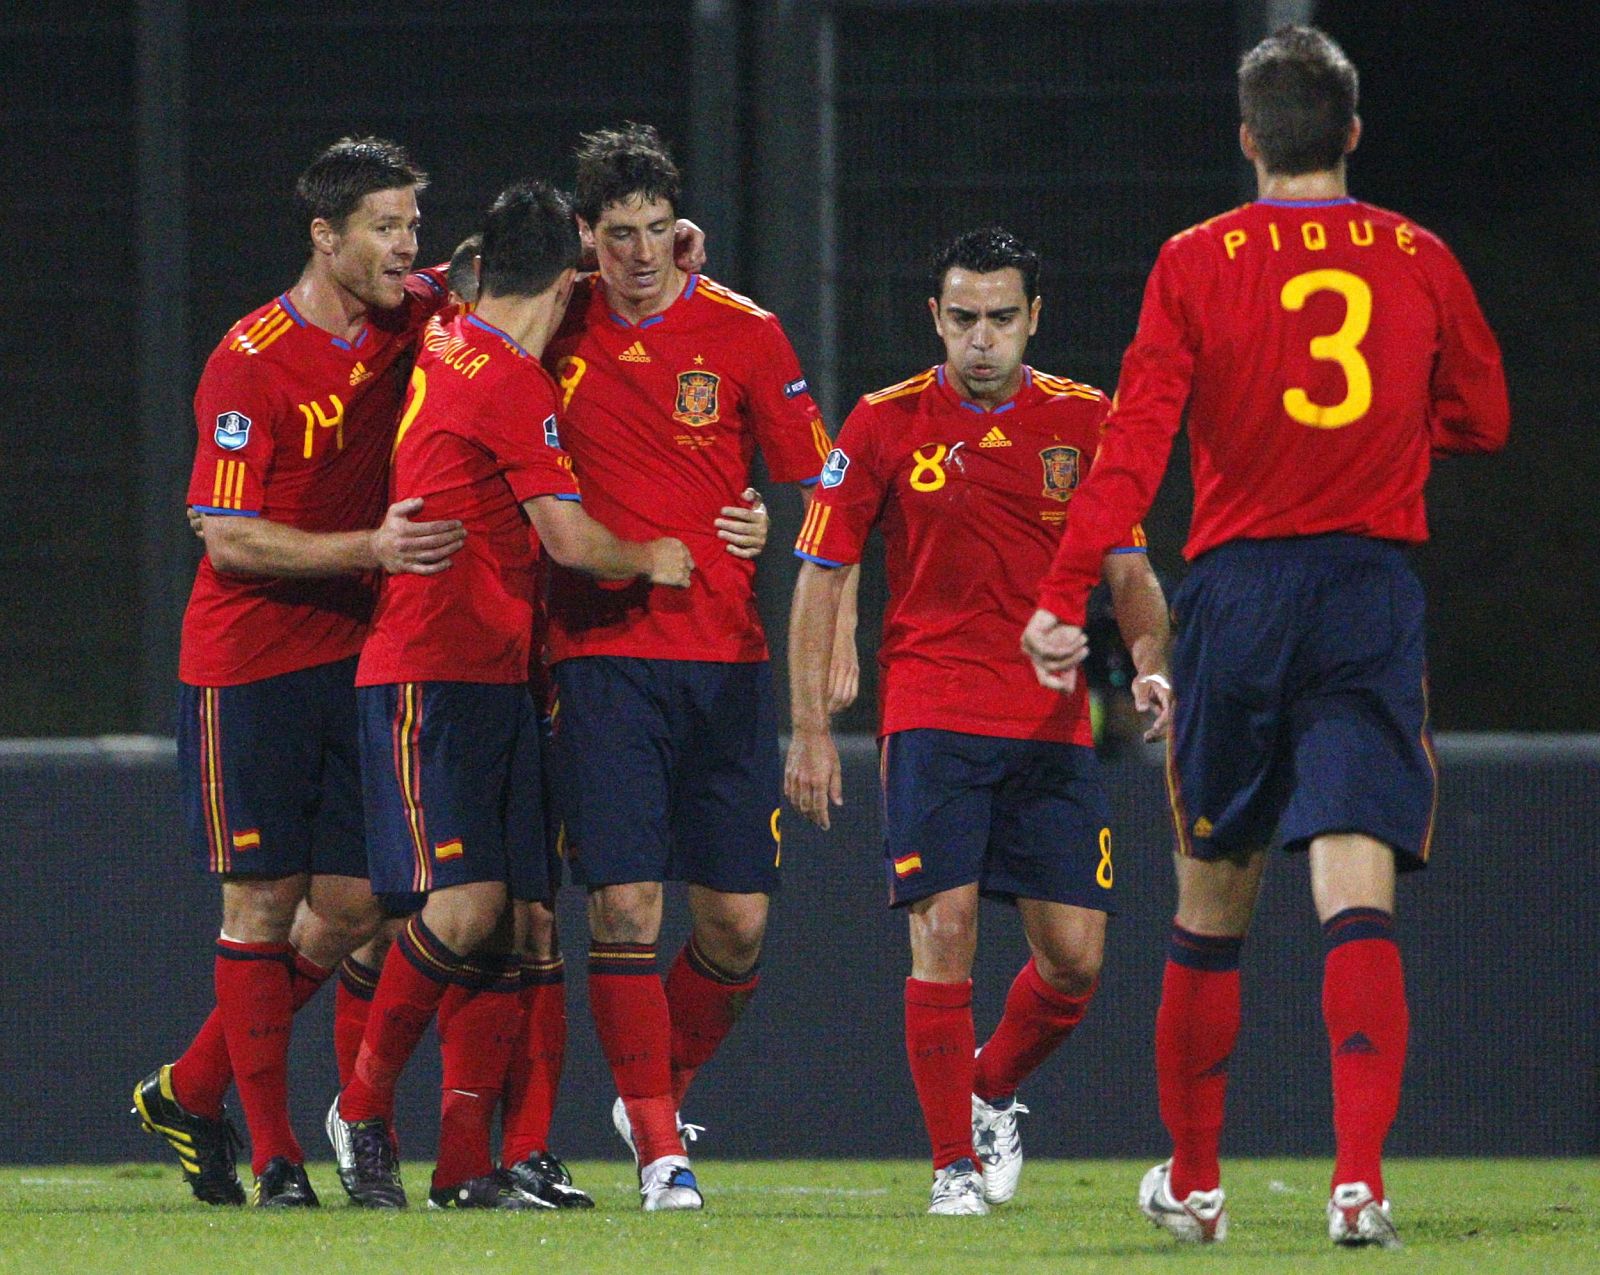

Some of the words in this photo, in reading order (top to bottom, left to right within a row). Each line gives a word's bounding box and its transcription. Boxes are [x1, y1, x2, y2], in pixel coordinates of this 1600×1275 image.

[618, 353, 651, 363] adidas
[1281, 269, 1373, 429] 3
[557, 355, 587, 414] 9
[298, 394, 343, 459] 14
[979, 439, 1012, 448] adidas
[909, 442, 946, 492] 8
[1095, 827, 1114, 890] 8
